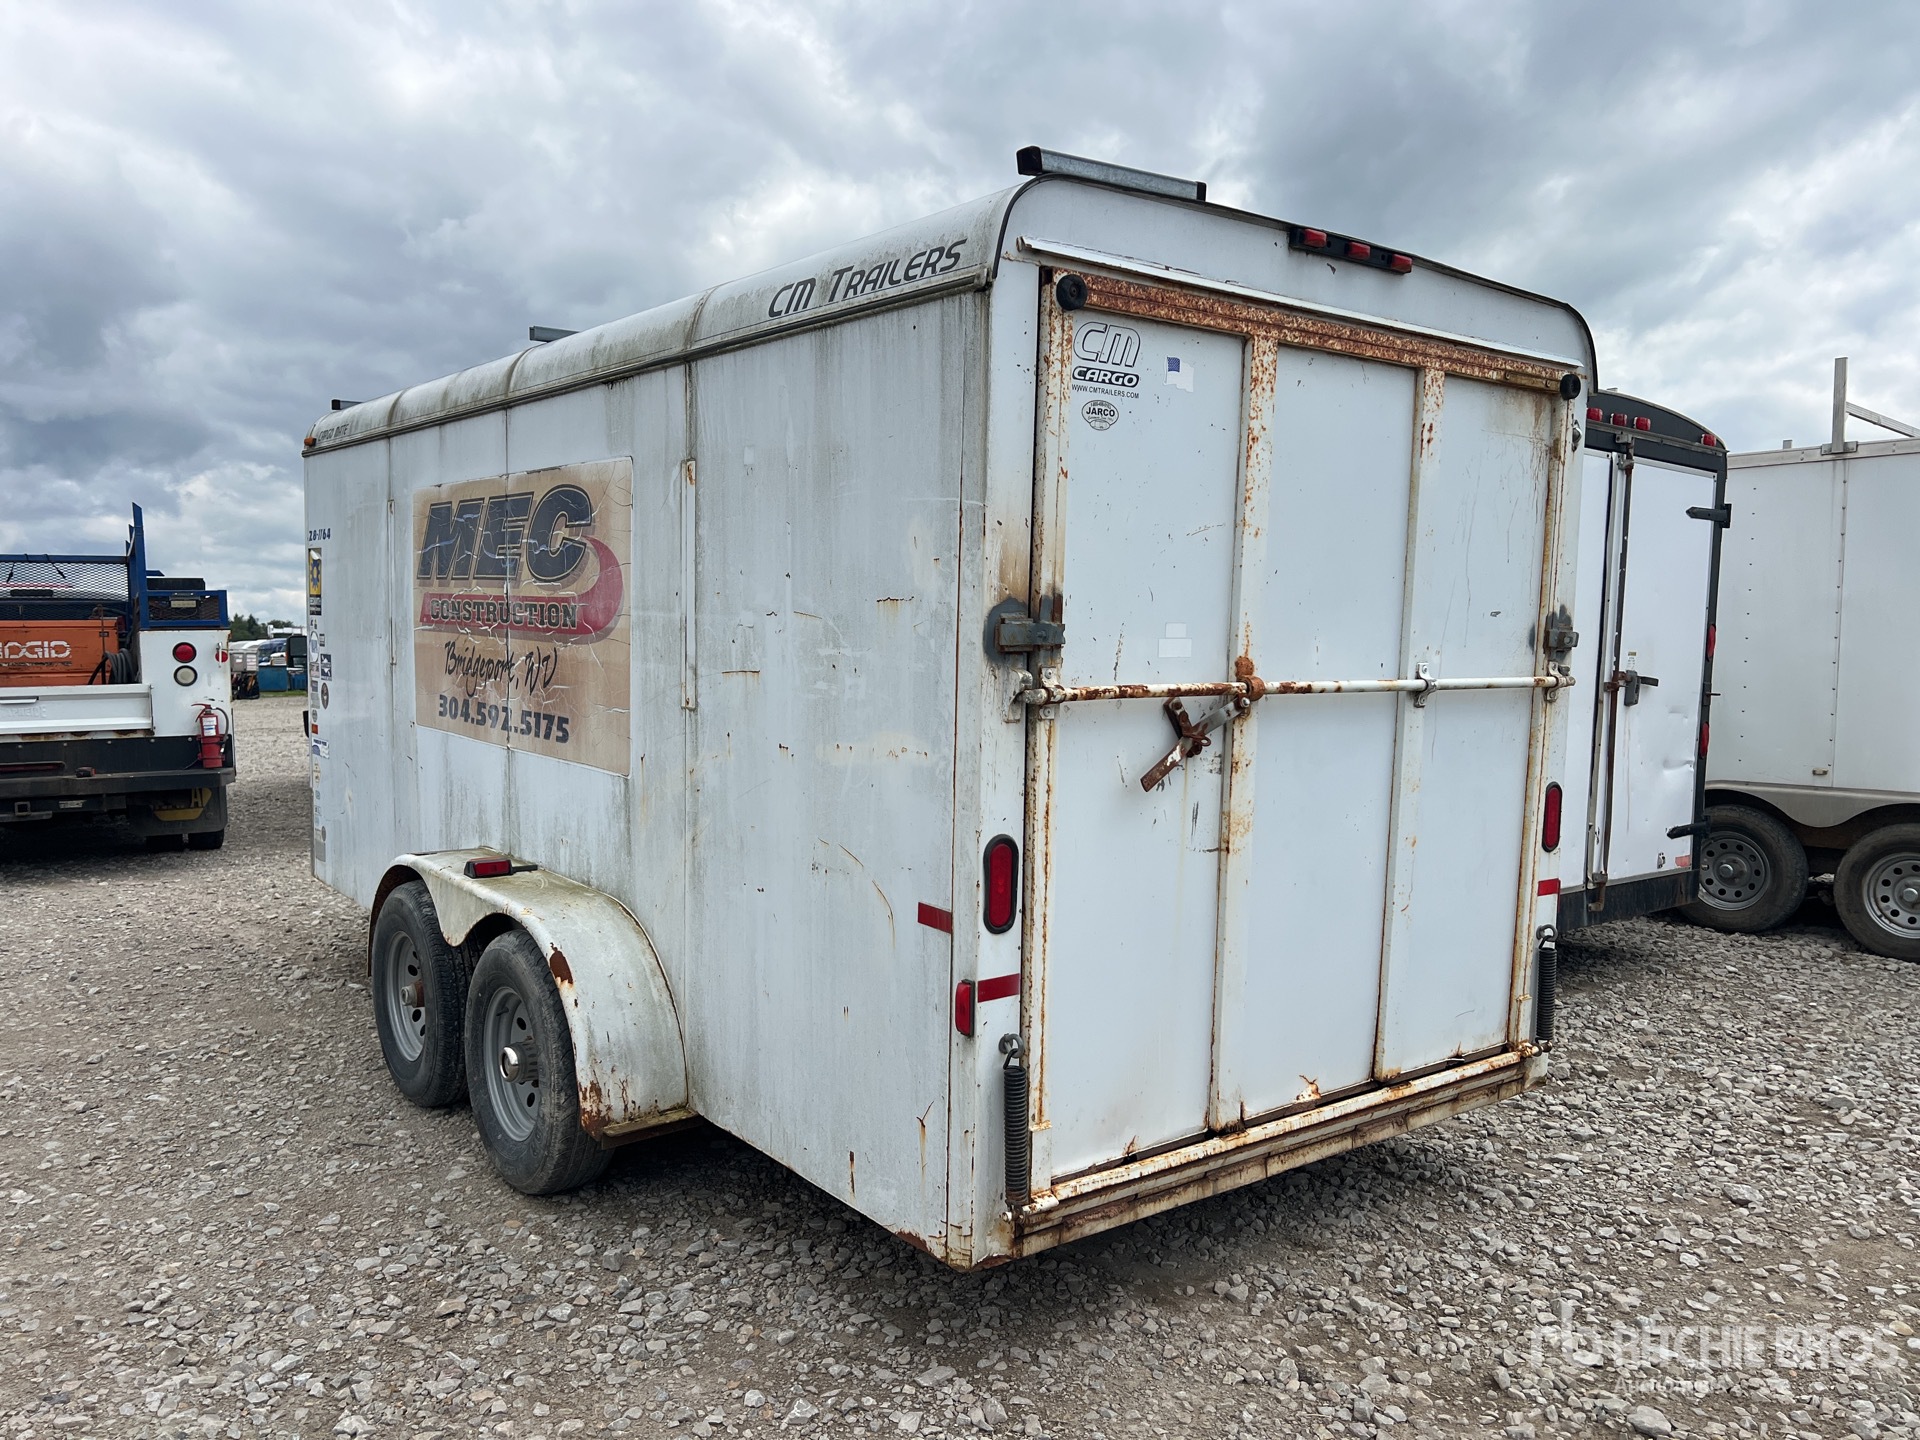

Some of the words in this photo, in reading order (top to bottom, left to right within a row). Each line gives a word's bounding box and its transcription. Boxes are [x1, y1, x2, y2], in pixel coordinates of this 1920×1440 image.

[768, 277, 817, 318] CM
[1073, 321, 1141, 368] CM
[1071, 384, 1140, 399] WWW.CMTRAILERS.COM
[1073, 366, 1139, 388] CARGO
[1086, 406, 1115, 417] JARCO
[416, 484, 593, 583] MEC
[430, 599, 578, 630] CONSTRUCTION
[438, 694, 570, 743] 304.592.5175
